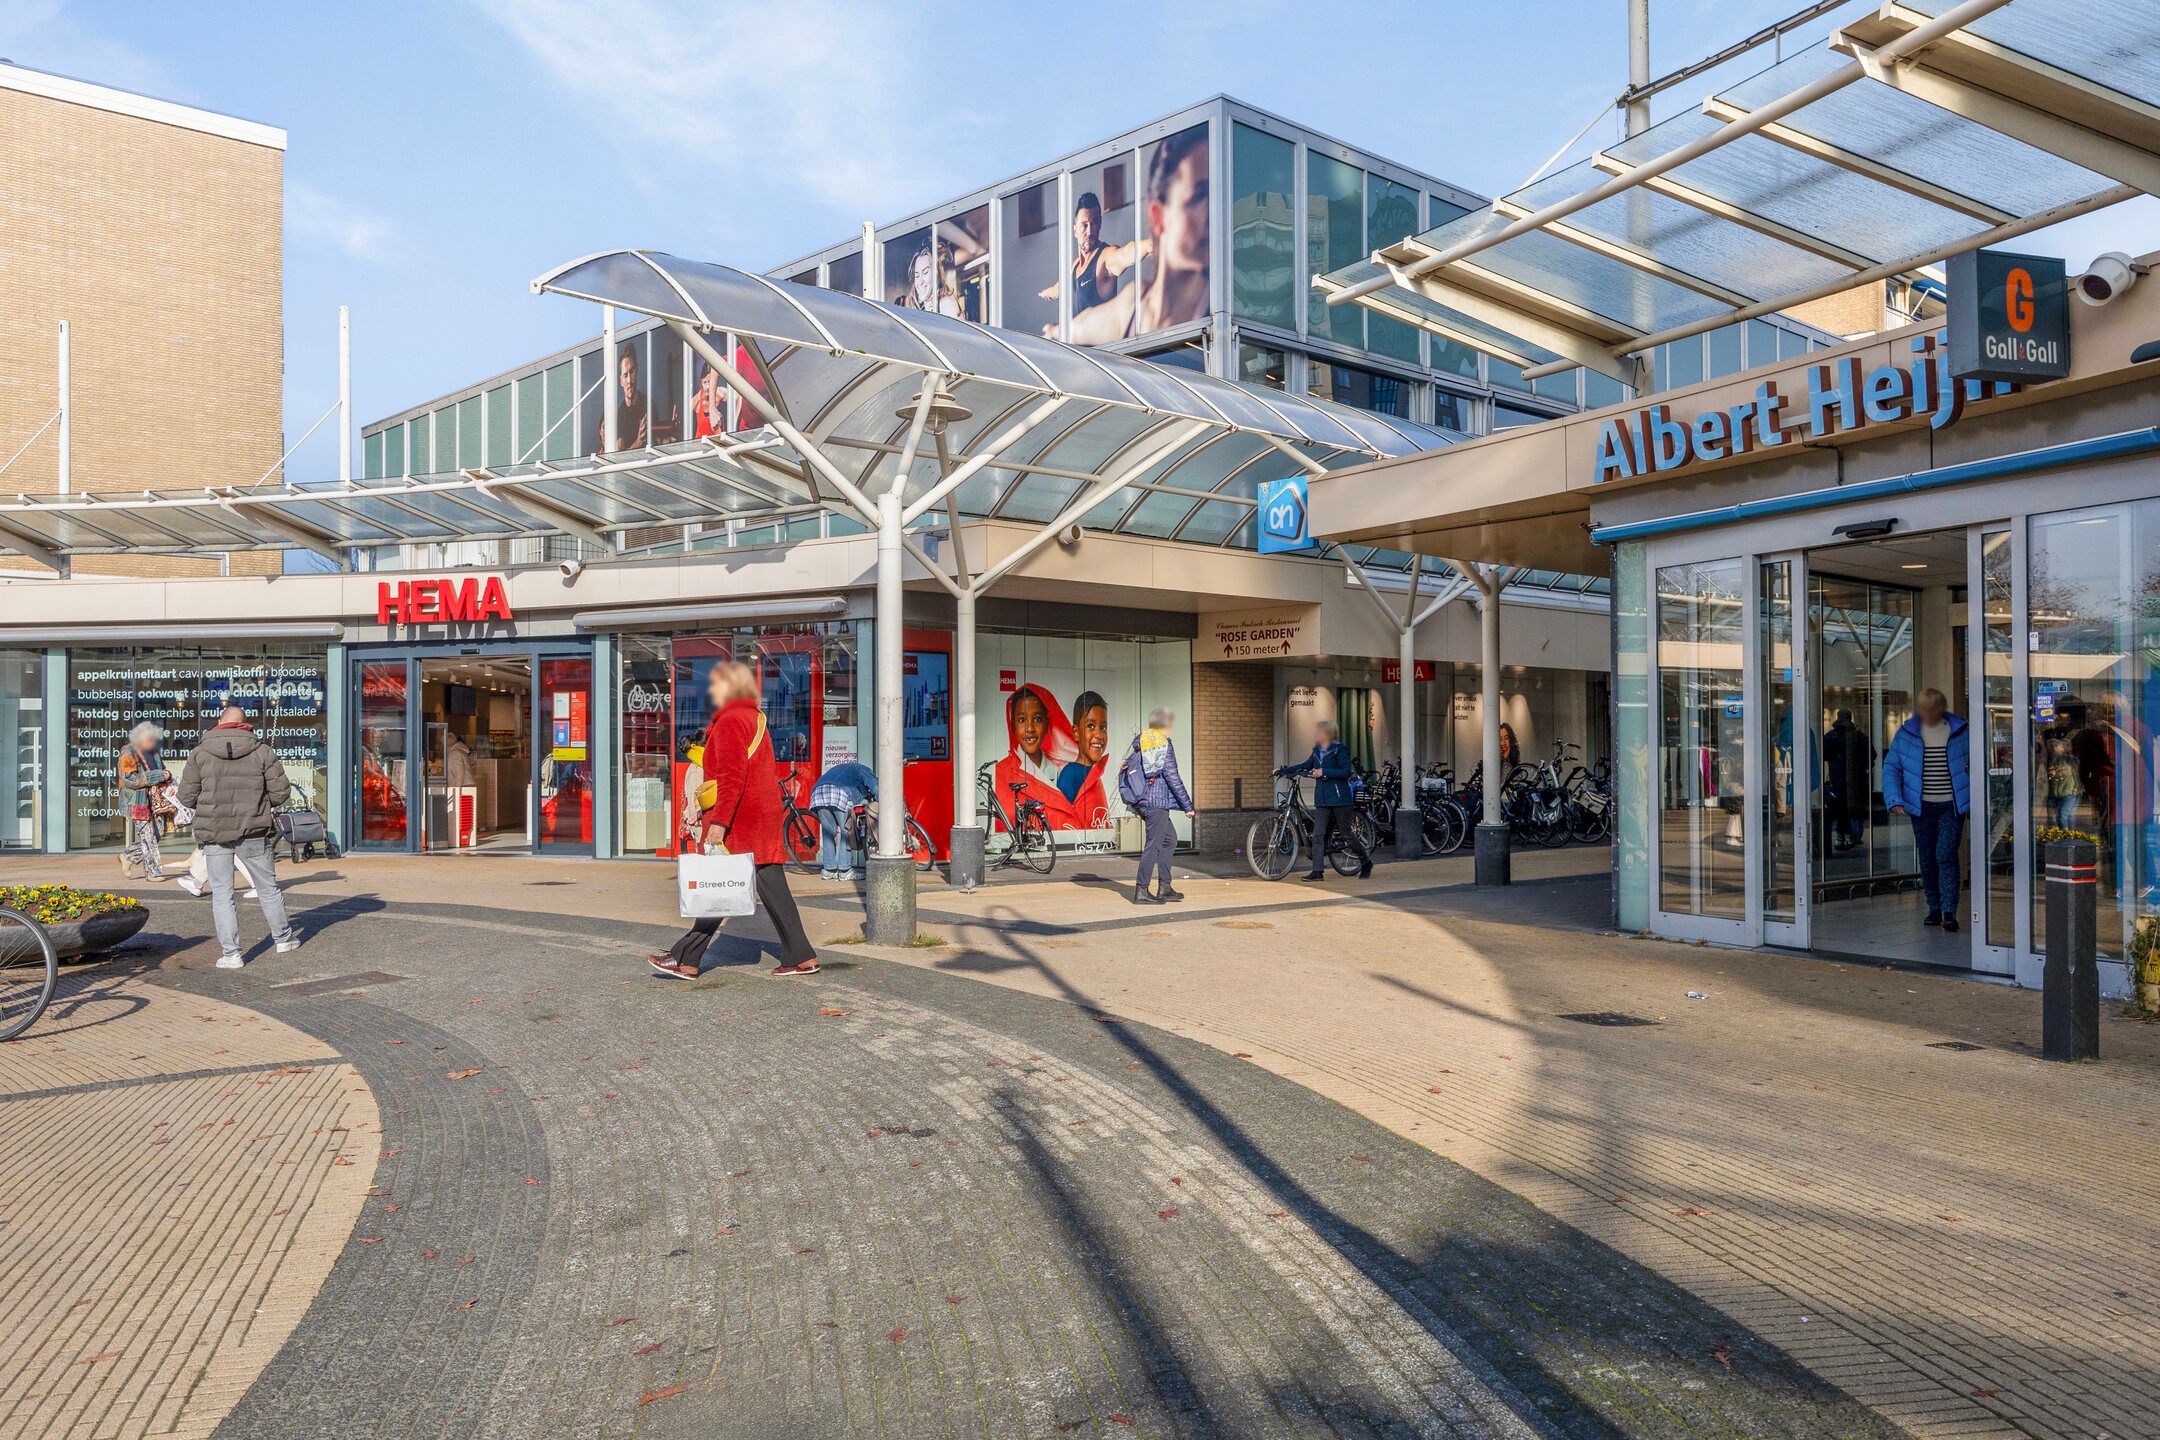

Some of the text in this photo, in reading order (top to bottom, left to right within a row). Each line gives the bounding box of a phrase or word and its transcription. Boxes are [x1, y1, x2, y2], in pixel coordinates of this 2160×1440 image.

[2006, 268, 2034, 332] G
[1986, 335, 2017, 360] Gall
[2026, 339, 2057, 364] Gall
[1595, 381, 1791, 483] Albert
[377, 577, 513, 624] HEMA
[1234, 645, 1280, 656] 150 meter
[271, 666, 317, 679] broodjes
[1387, 666, 1424, 680] HEA
[137, 688, 189, 699] ookworst
[78, 709, 119, 721] hotdog
[78, 728, 130, 739] kombuch
[266, 726, 317, 739] potsnoep
[78, 747, 110, 758] koffie
[78, 767, 97, 778] red
[78, 787, 103, 797] rosé
[698, 880, 746, 889] Street One
